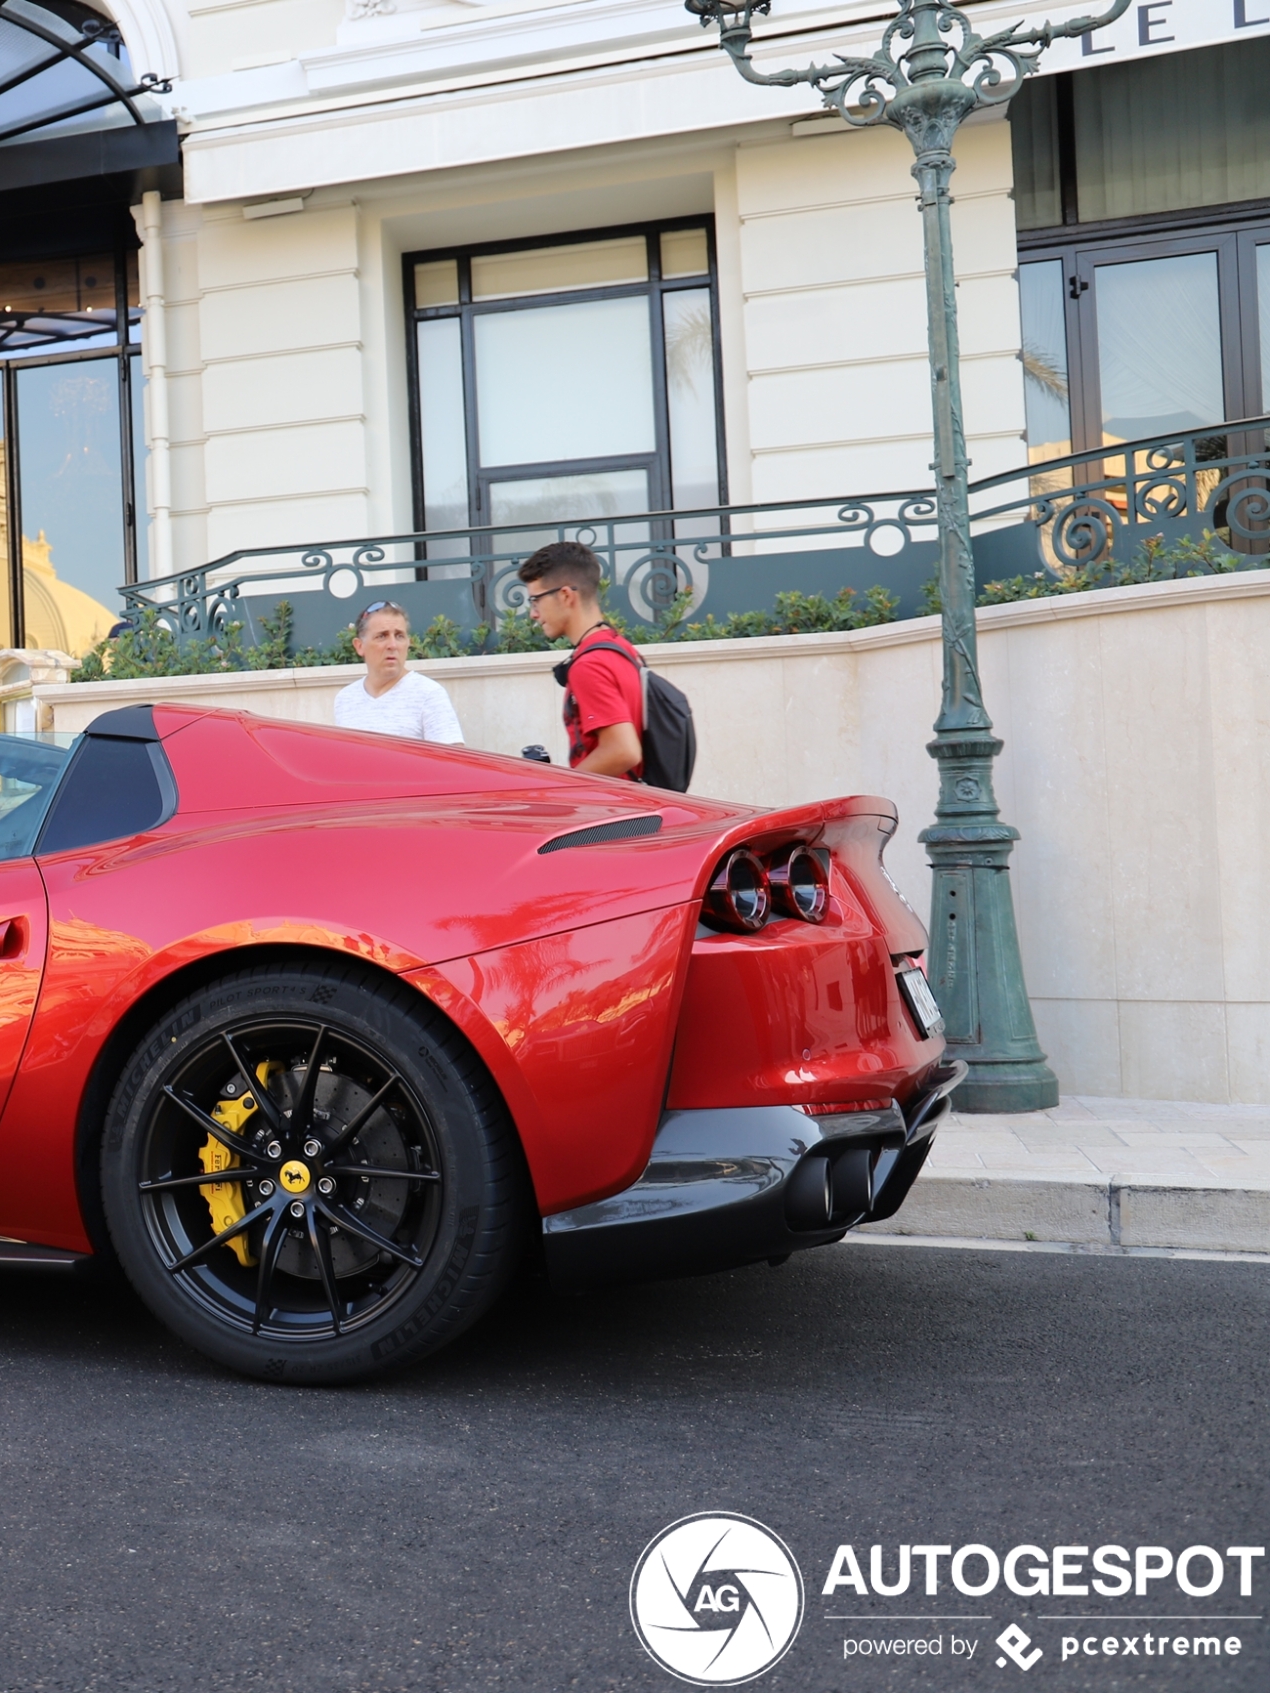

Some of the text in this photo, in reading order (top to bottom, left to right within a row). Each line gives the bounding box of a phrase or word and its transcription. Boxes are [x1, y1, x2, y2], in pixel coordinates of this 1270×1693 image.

[209, 991, 242, 1009] PILOT
[117, 1009, 195, 1118] MICHELIN
[378, 1245, 469, 1356] MICHELIN
